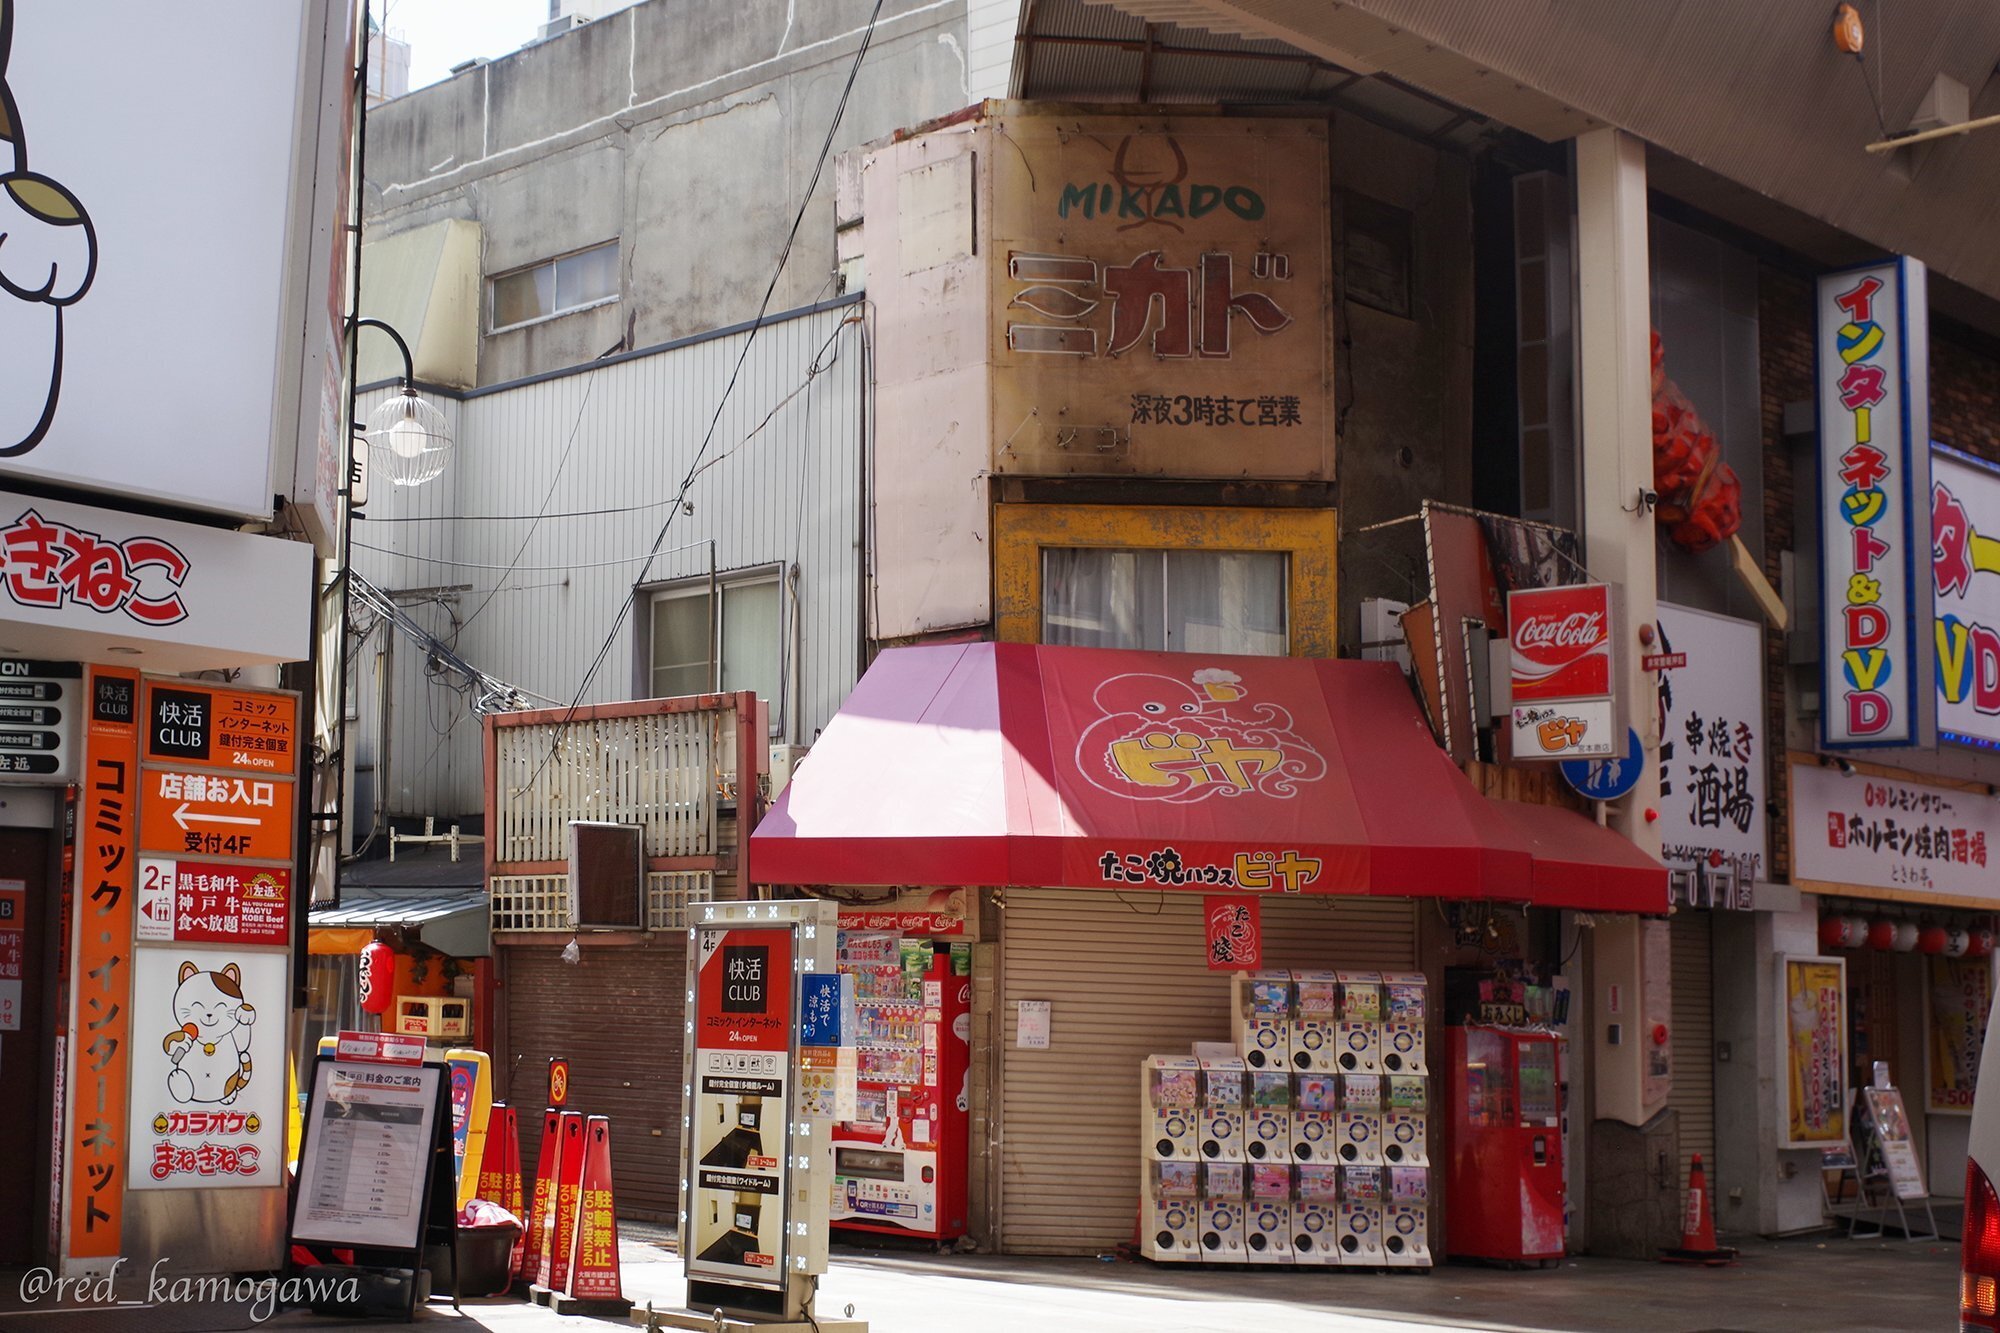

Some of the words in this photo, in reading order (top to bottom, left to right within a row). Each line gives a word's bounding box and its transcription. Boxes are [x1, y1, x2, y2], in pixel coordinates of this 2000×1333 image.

[1058, 182, 1266, 222] MIKADO
[1008, 250, 1294, 359] ミカド
[1834, 276, 1892, 737] インターネット&DVD
[0, 508, 190, 626] きねこ
[1515, 611, 1604, 650] Coca-Cola
[99, 684, 129, 702] 快活
[99, 702, 128, 715] CLUB
[159, 701, 203, 728] 快活
[232, 700, 278, 716] コミック
[218, 716, 290, 734] インターネット
[159, 731, 202, 748] CLUB
[218, 733, 289, 752] 鍵付完全個室
[158, 773, 274, 807] 店舗お入口
[1687, 763, 1755, 834] 酒場
[184, 832, 252, 855] 受付4F
[1848, 812, 1987, 868] ホルモン焼肉酒場
[143, 865, 172, 891] 2F
[178, 873, 240, 894] 黒毛和牛
[178, 893, 240, 914] 神戸牛
[242, 907, 272, 915] WAGYU
[177, 913, 239, 934] 食べ放題
[703, 931, 717, 939] 受付
[703, 939, 716, 952] 4F
[728, 957, 761, 981] 快活
[728, 985, 761, 1001] CLUB
[819, 984, 831, 1026] 快活で
[706, 1016, 782, 1029] コミック・インターネット
[365, 1073, 421, 1087] 料金のご案内
[168, 1111, 248, 1134] カラオケ
[151, 1141, 261, 1181] まねきねこ
[536, 1178, 545, 1196] NO
[561, 1184, 570, 1203] NO
[584, 1190, 594, 1209] NO
[532, 1198, 544, 1250] PARKING
[560, 1205, 570, 1259] PARKING
[583, 1212, 594, 1267] PARKING
